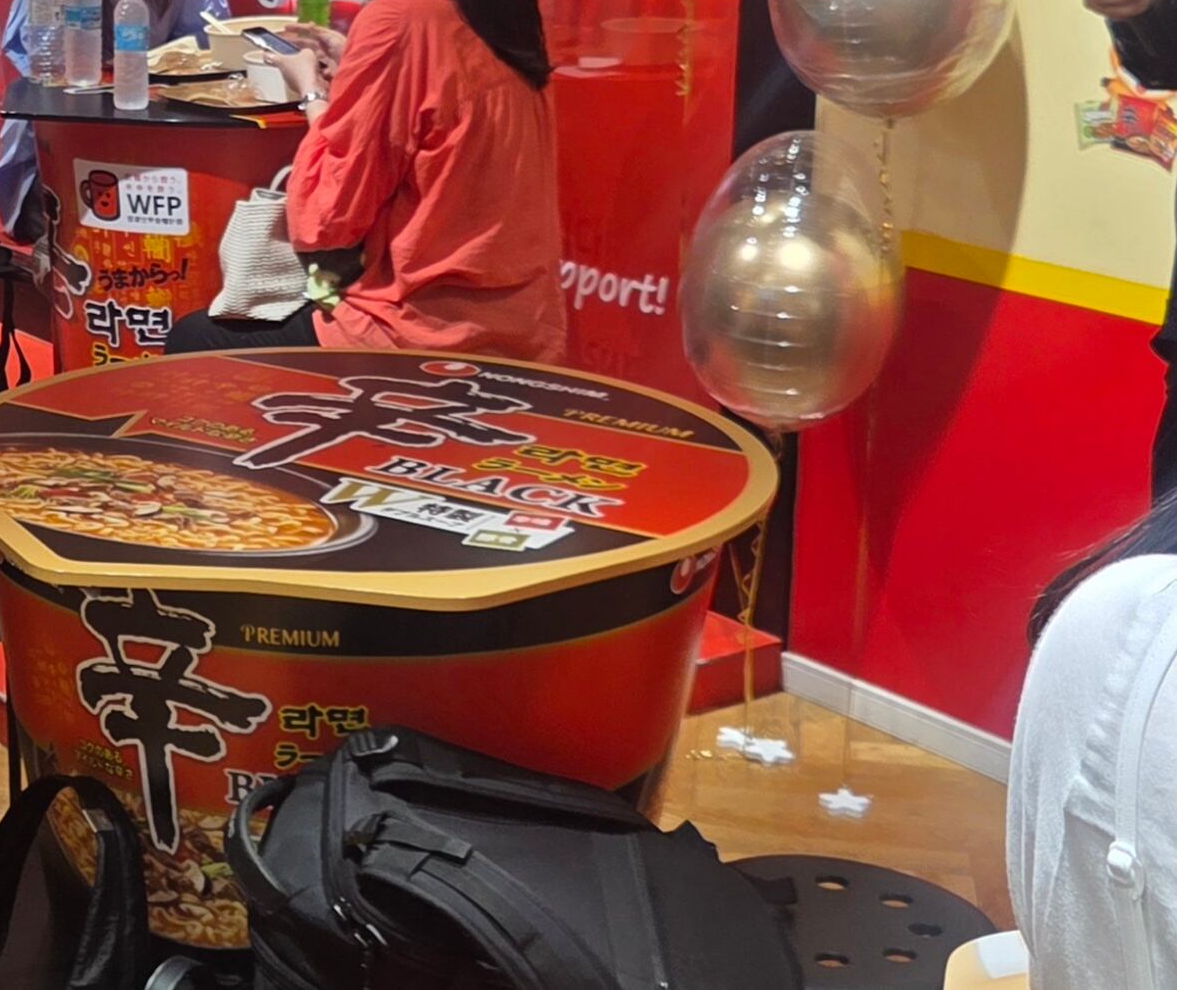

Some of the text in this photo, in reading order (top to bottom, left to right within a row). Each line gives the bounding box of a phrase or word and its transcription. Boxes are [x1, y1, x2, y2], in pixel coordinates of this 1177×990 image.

[126, 193, 183, 217] WFP
[83, 298, 172, 347] 라면
[232, 376, 537, 470] 辛
[562, 408, 696, 439] PREMIUM
[364, 456, 625, 519] BLACK
[239, 623, 341, 648] PREMIUM
[76, 587, 273, 856] 辛
[277, 702, 372, 741] 라면
